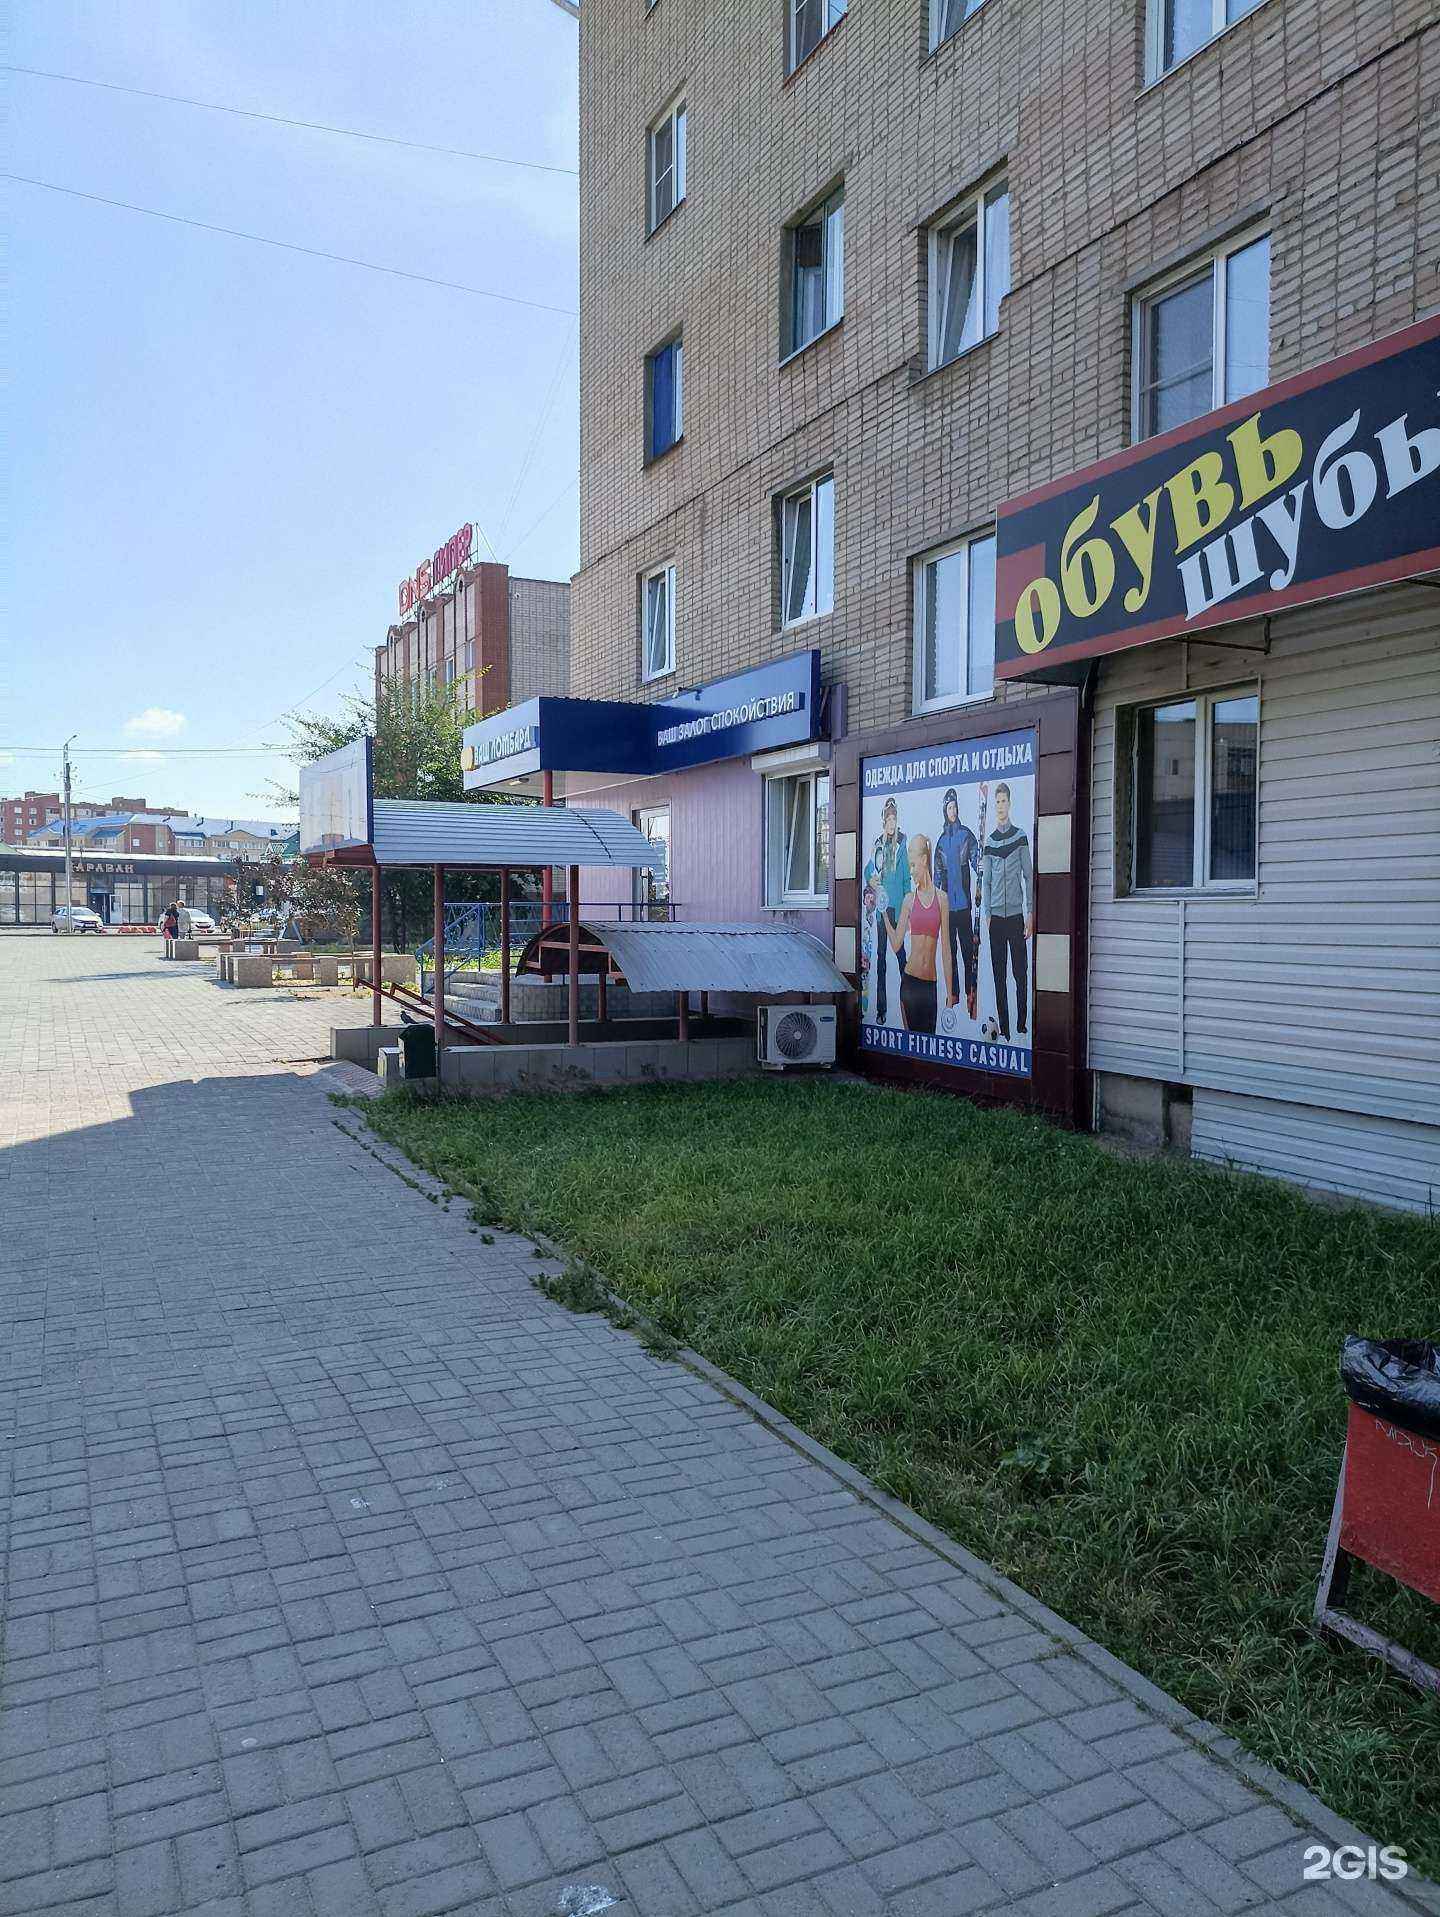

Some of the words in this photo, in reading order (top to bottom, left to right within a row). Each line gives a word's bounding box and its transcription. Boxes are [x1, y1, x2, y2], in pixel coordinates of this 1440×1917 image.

[658, 726, 679, 746] ВАШ
[679, 717, 709, 739] ЗАЛОГ
[711, 692, 794, 730] СПОКОЙСТВИЯ
[474, 744, 490, 766] ВАШ
[490, 725, 531, 760] ЛОМБАРД
[865, 764, 903, 788] ОДЕЖДА
[906, 760, 926, 783] ДЛЯ
[928, 754, 969, 777] СПОРТА
[971, 751, 980, 771] И
[982, 742, 1033, 771] ОТДЫХА
[865, 1027, 903, 1049] SPORT
[908, 1034, 963, 1061] FITNESS
[969, 1043, 1028, 1072] CASUAL
